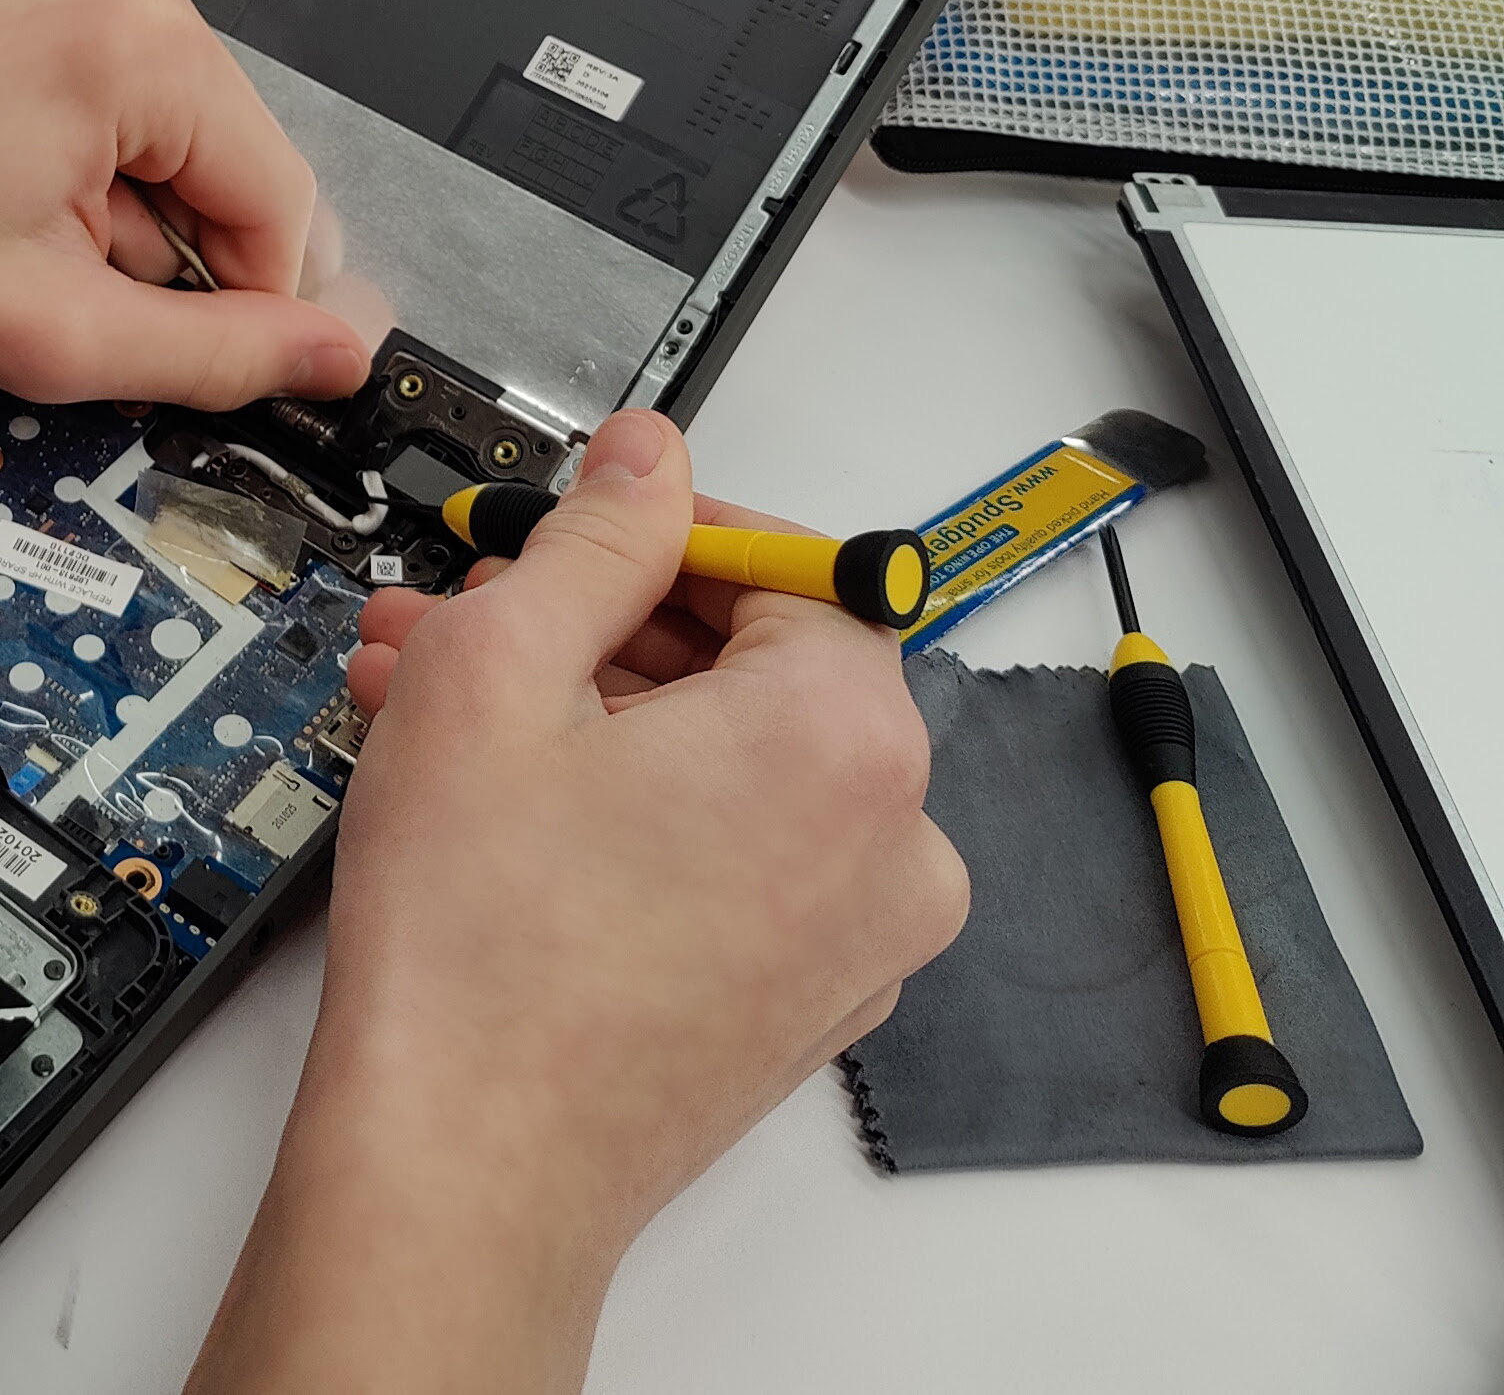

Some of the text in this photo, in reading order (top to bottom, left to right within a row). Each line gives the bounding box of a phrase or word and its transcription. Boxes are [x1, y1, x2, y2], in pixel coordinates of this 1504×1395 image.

[1077, 487, 1109, 512] Hand
[1045, 504, 1079, 533] picked
[987, 525, 1013, 546] THE
[1012, 526, 1047, 555] quality
[943, 539, 991, 575] OPENING
[986, 548, 1015, 573] tools
[28, 569, 42, 579] HP
[42, 574, 66, 588] WITH
[971, 565, 990, 584] for
[68, 583, 112, 605] REPLACE
